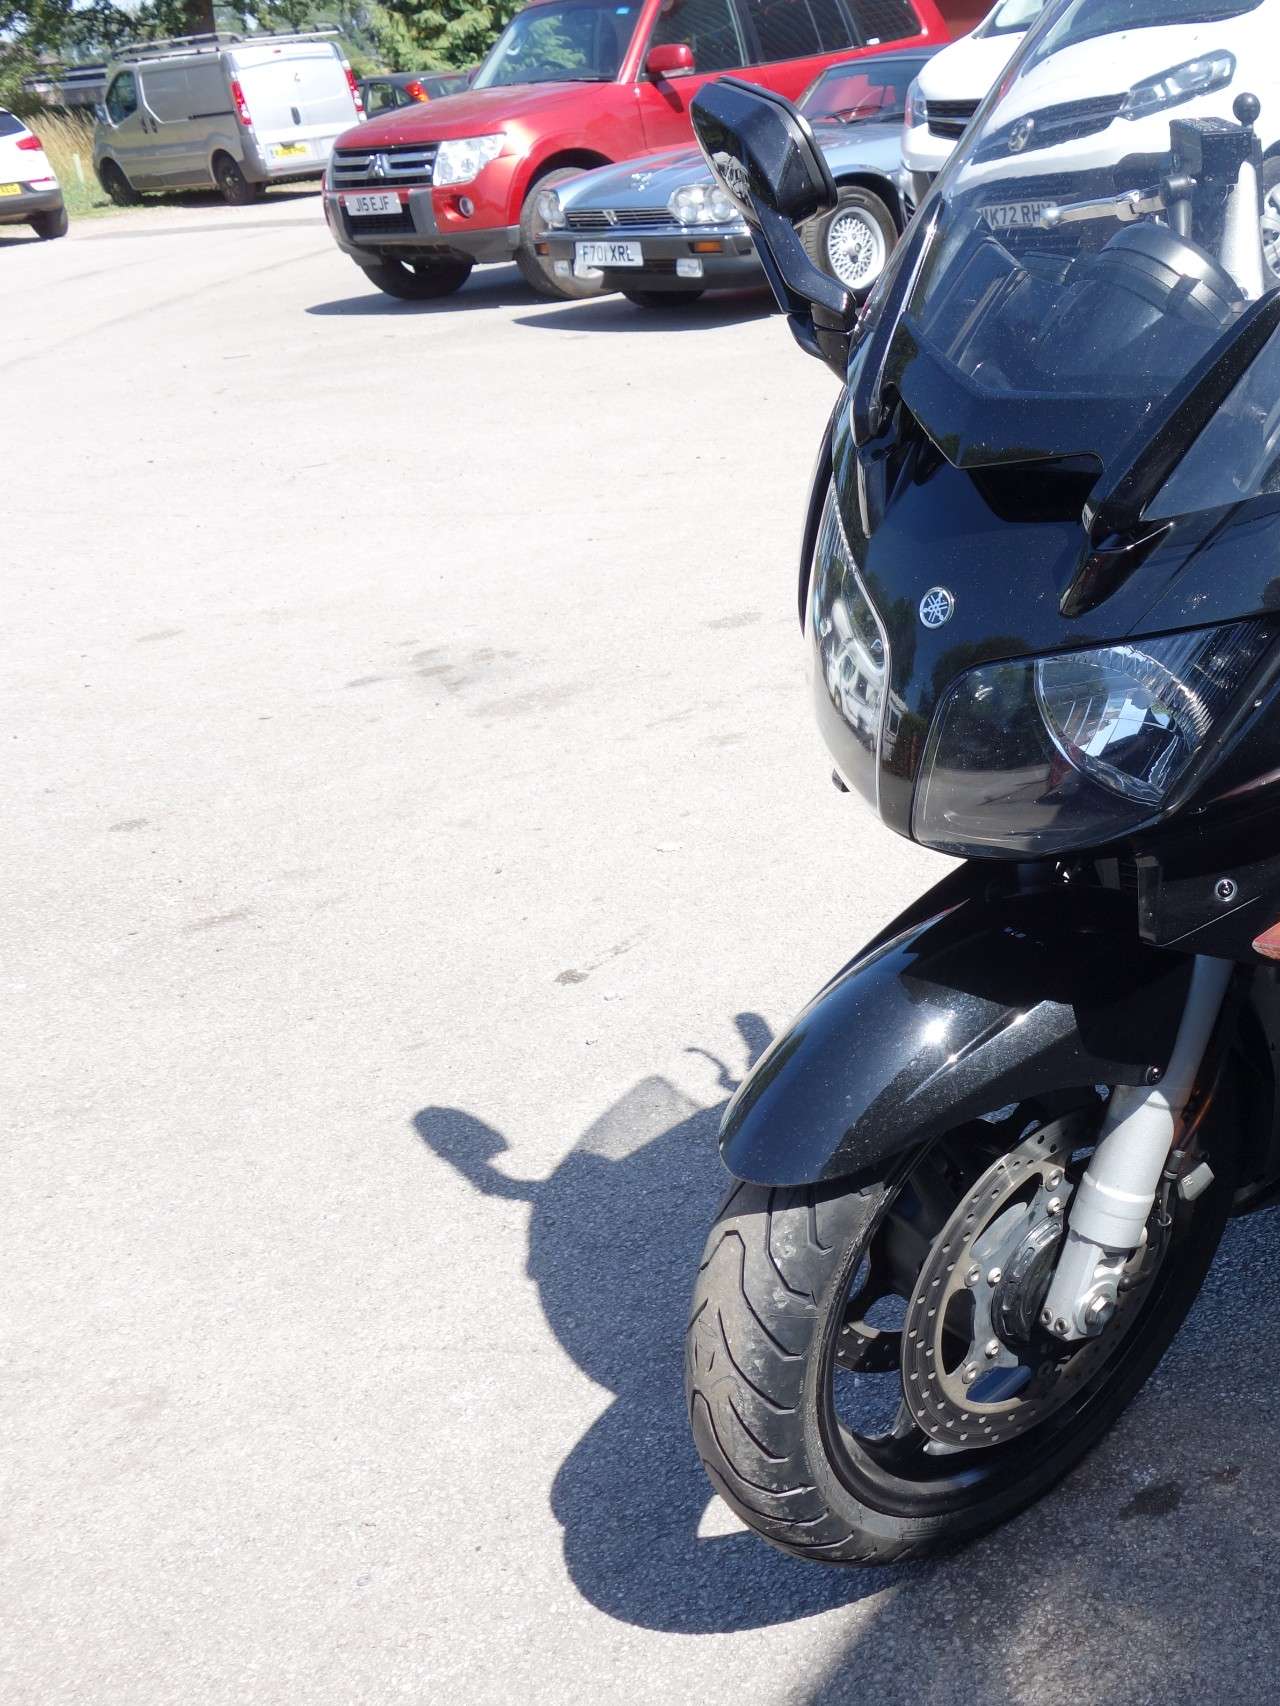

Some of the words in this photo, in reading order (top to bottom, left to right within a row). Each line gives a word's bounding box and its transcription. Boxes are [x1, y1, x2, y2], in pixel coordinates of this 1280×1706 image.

[369, 195, 389, 211] EJF
[582, 244, 607, 262] F701
[609, 244, 635, 262] XRL
